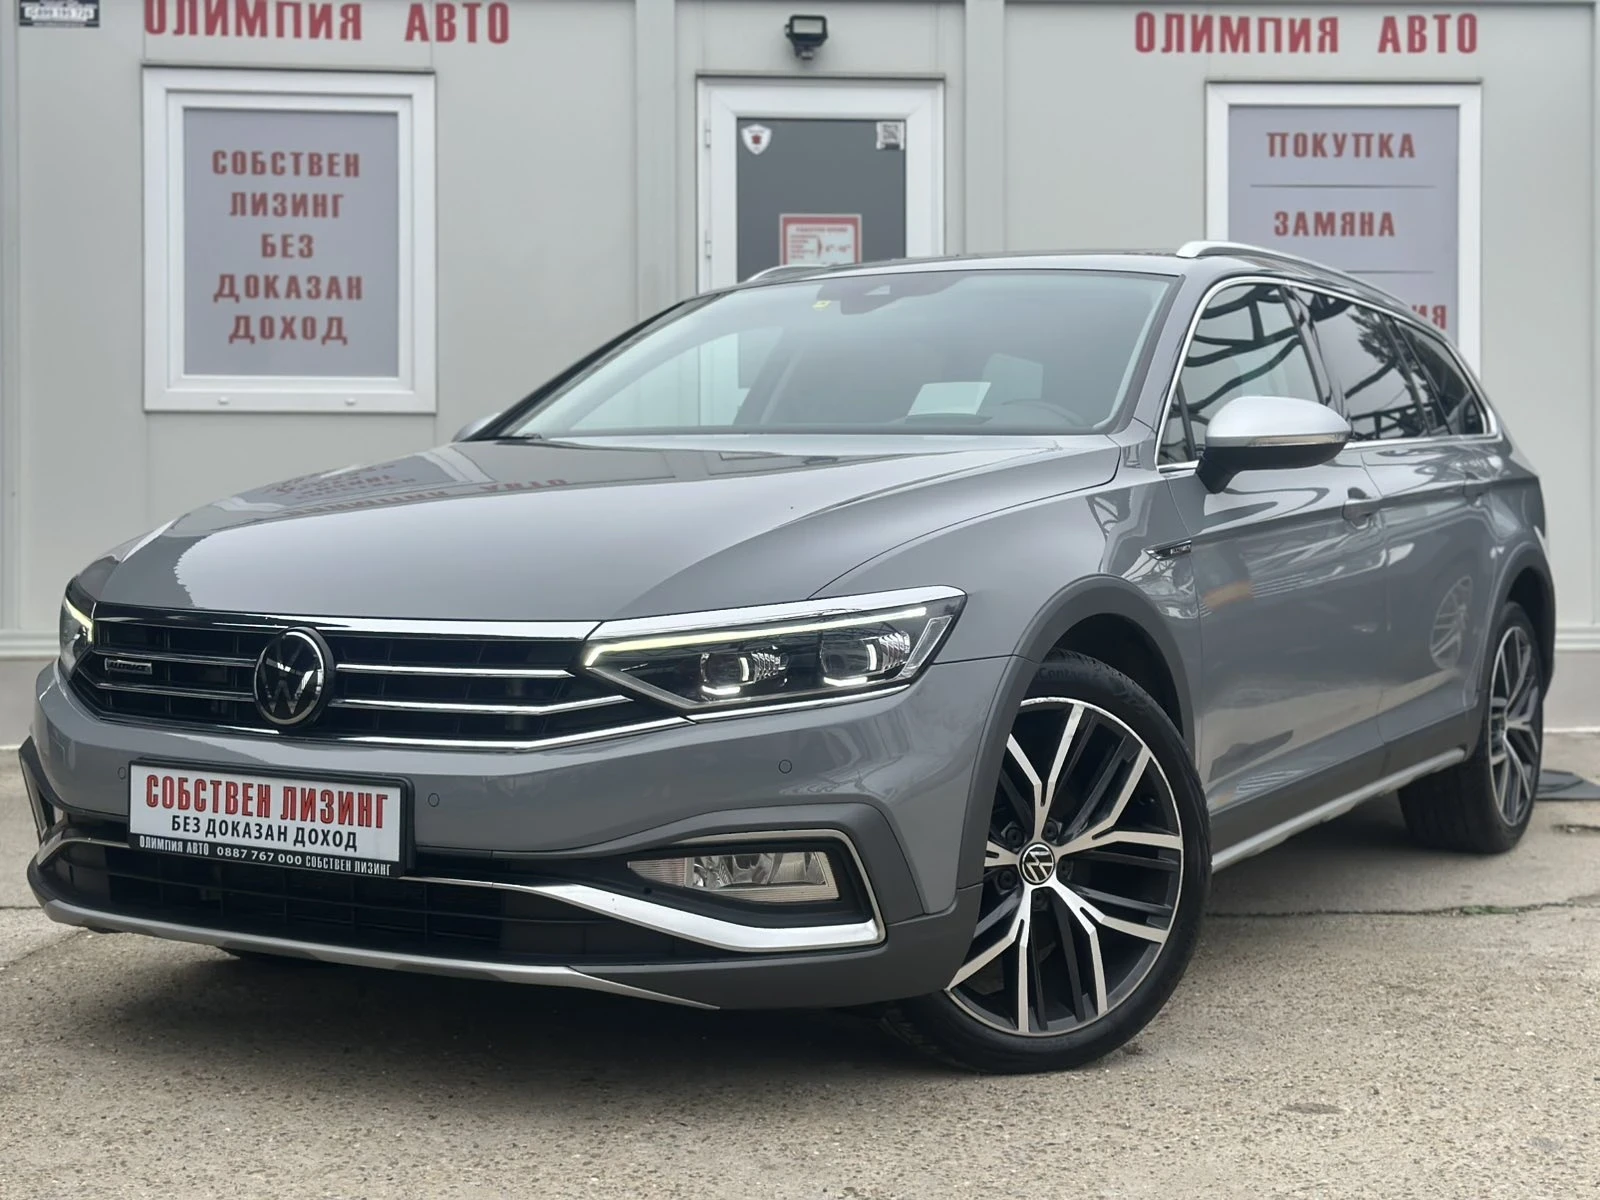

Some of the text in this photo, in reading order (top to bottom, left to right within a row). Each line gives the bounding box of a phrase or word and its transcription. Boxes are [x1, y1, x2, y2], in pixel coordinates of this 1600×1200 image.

[144, 0, 510, 45] ОЛИМПИЯ АВТО
[1134, 11, 1478, 54] ОЛИМПИЯ АВТО
[1266, 131, 1416, 159] ПОКУПКА
[212, 150, 360, 178] СОБСТВЕН
[229, 192, 344, 218] ЛИЗИНГ
[1274, 210, 1395, 237] ЗАМЯНА
[260, 233, 313, 259] БЕЗ
[213, 274, 363, 303] ДОКАЗАН
[228, 315, 348, 346] ДОХОД
[145, 774, 389, 830] СОБСТВЕН ЛИЗИНГ
[171, 815, 358, 852] БЕЗ ДОКАЗАН ДОХОД
[139, 835, 392, 877] ОЛИМПИЯ АВТО 0887 767 000 СОБСТВЕН ЛИЗИНГ
